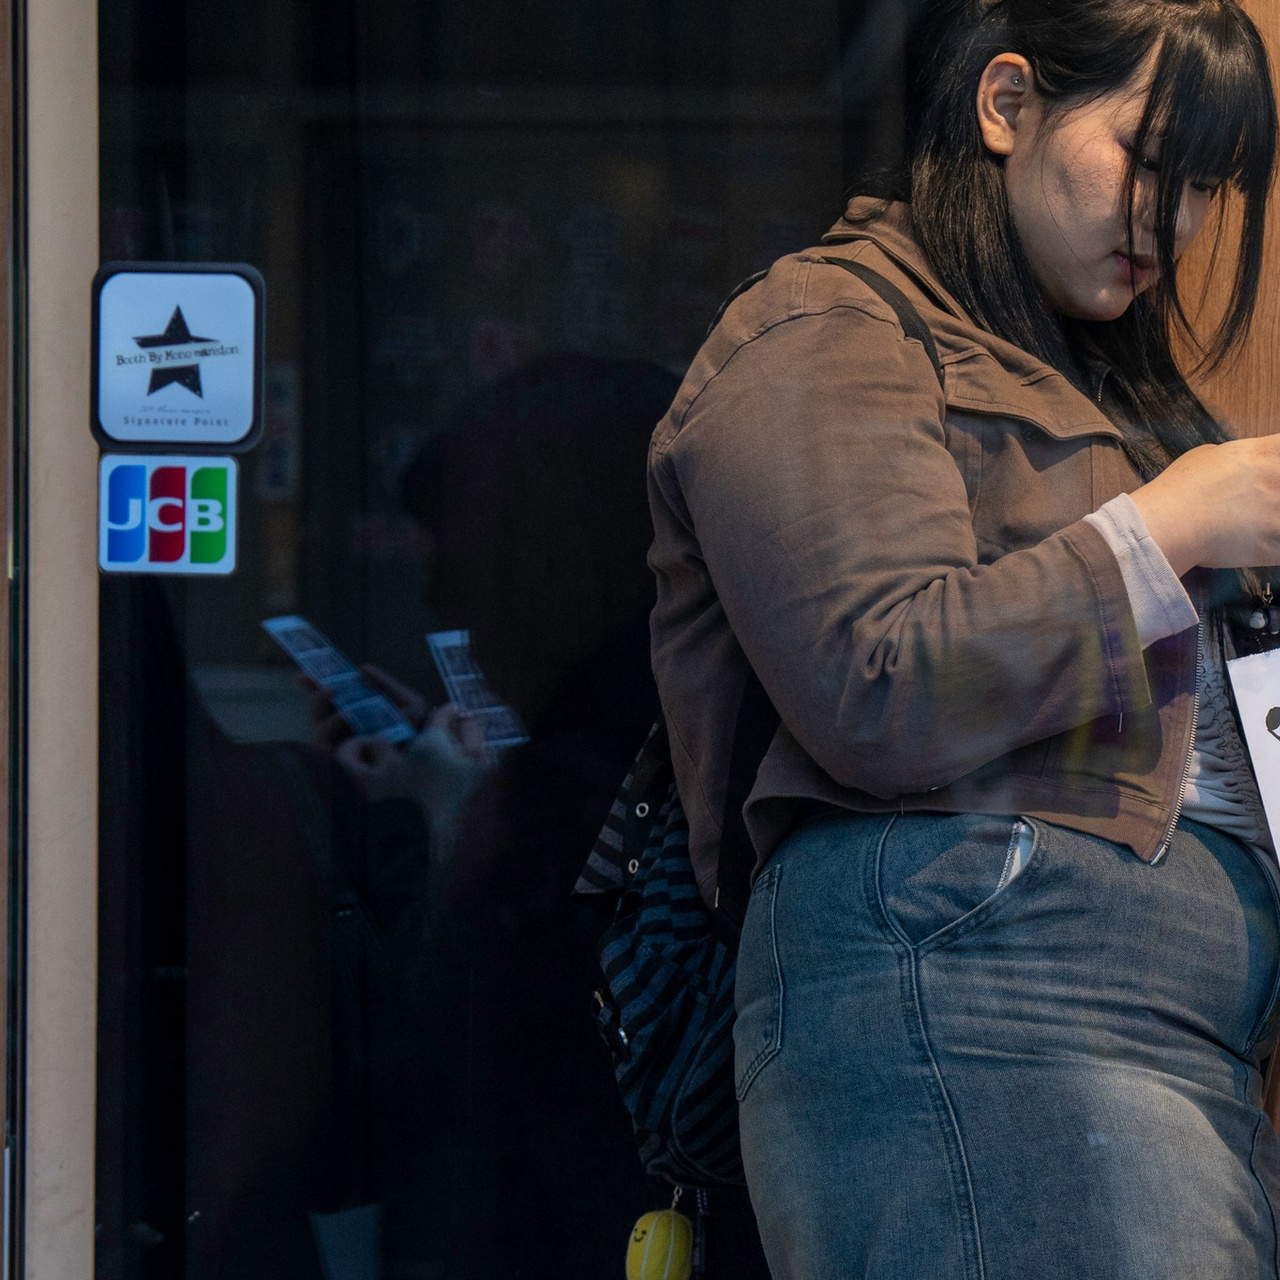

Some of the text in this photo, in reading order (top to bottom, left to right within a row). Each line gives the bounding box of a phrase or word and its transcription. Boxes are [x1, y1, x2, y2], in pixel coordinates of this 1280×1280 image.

[116, 345, 239, 366] Booth By Mono mansion
[123, 415, 229, 427] Signature Point
